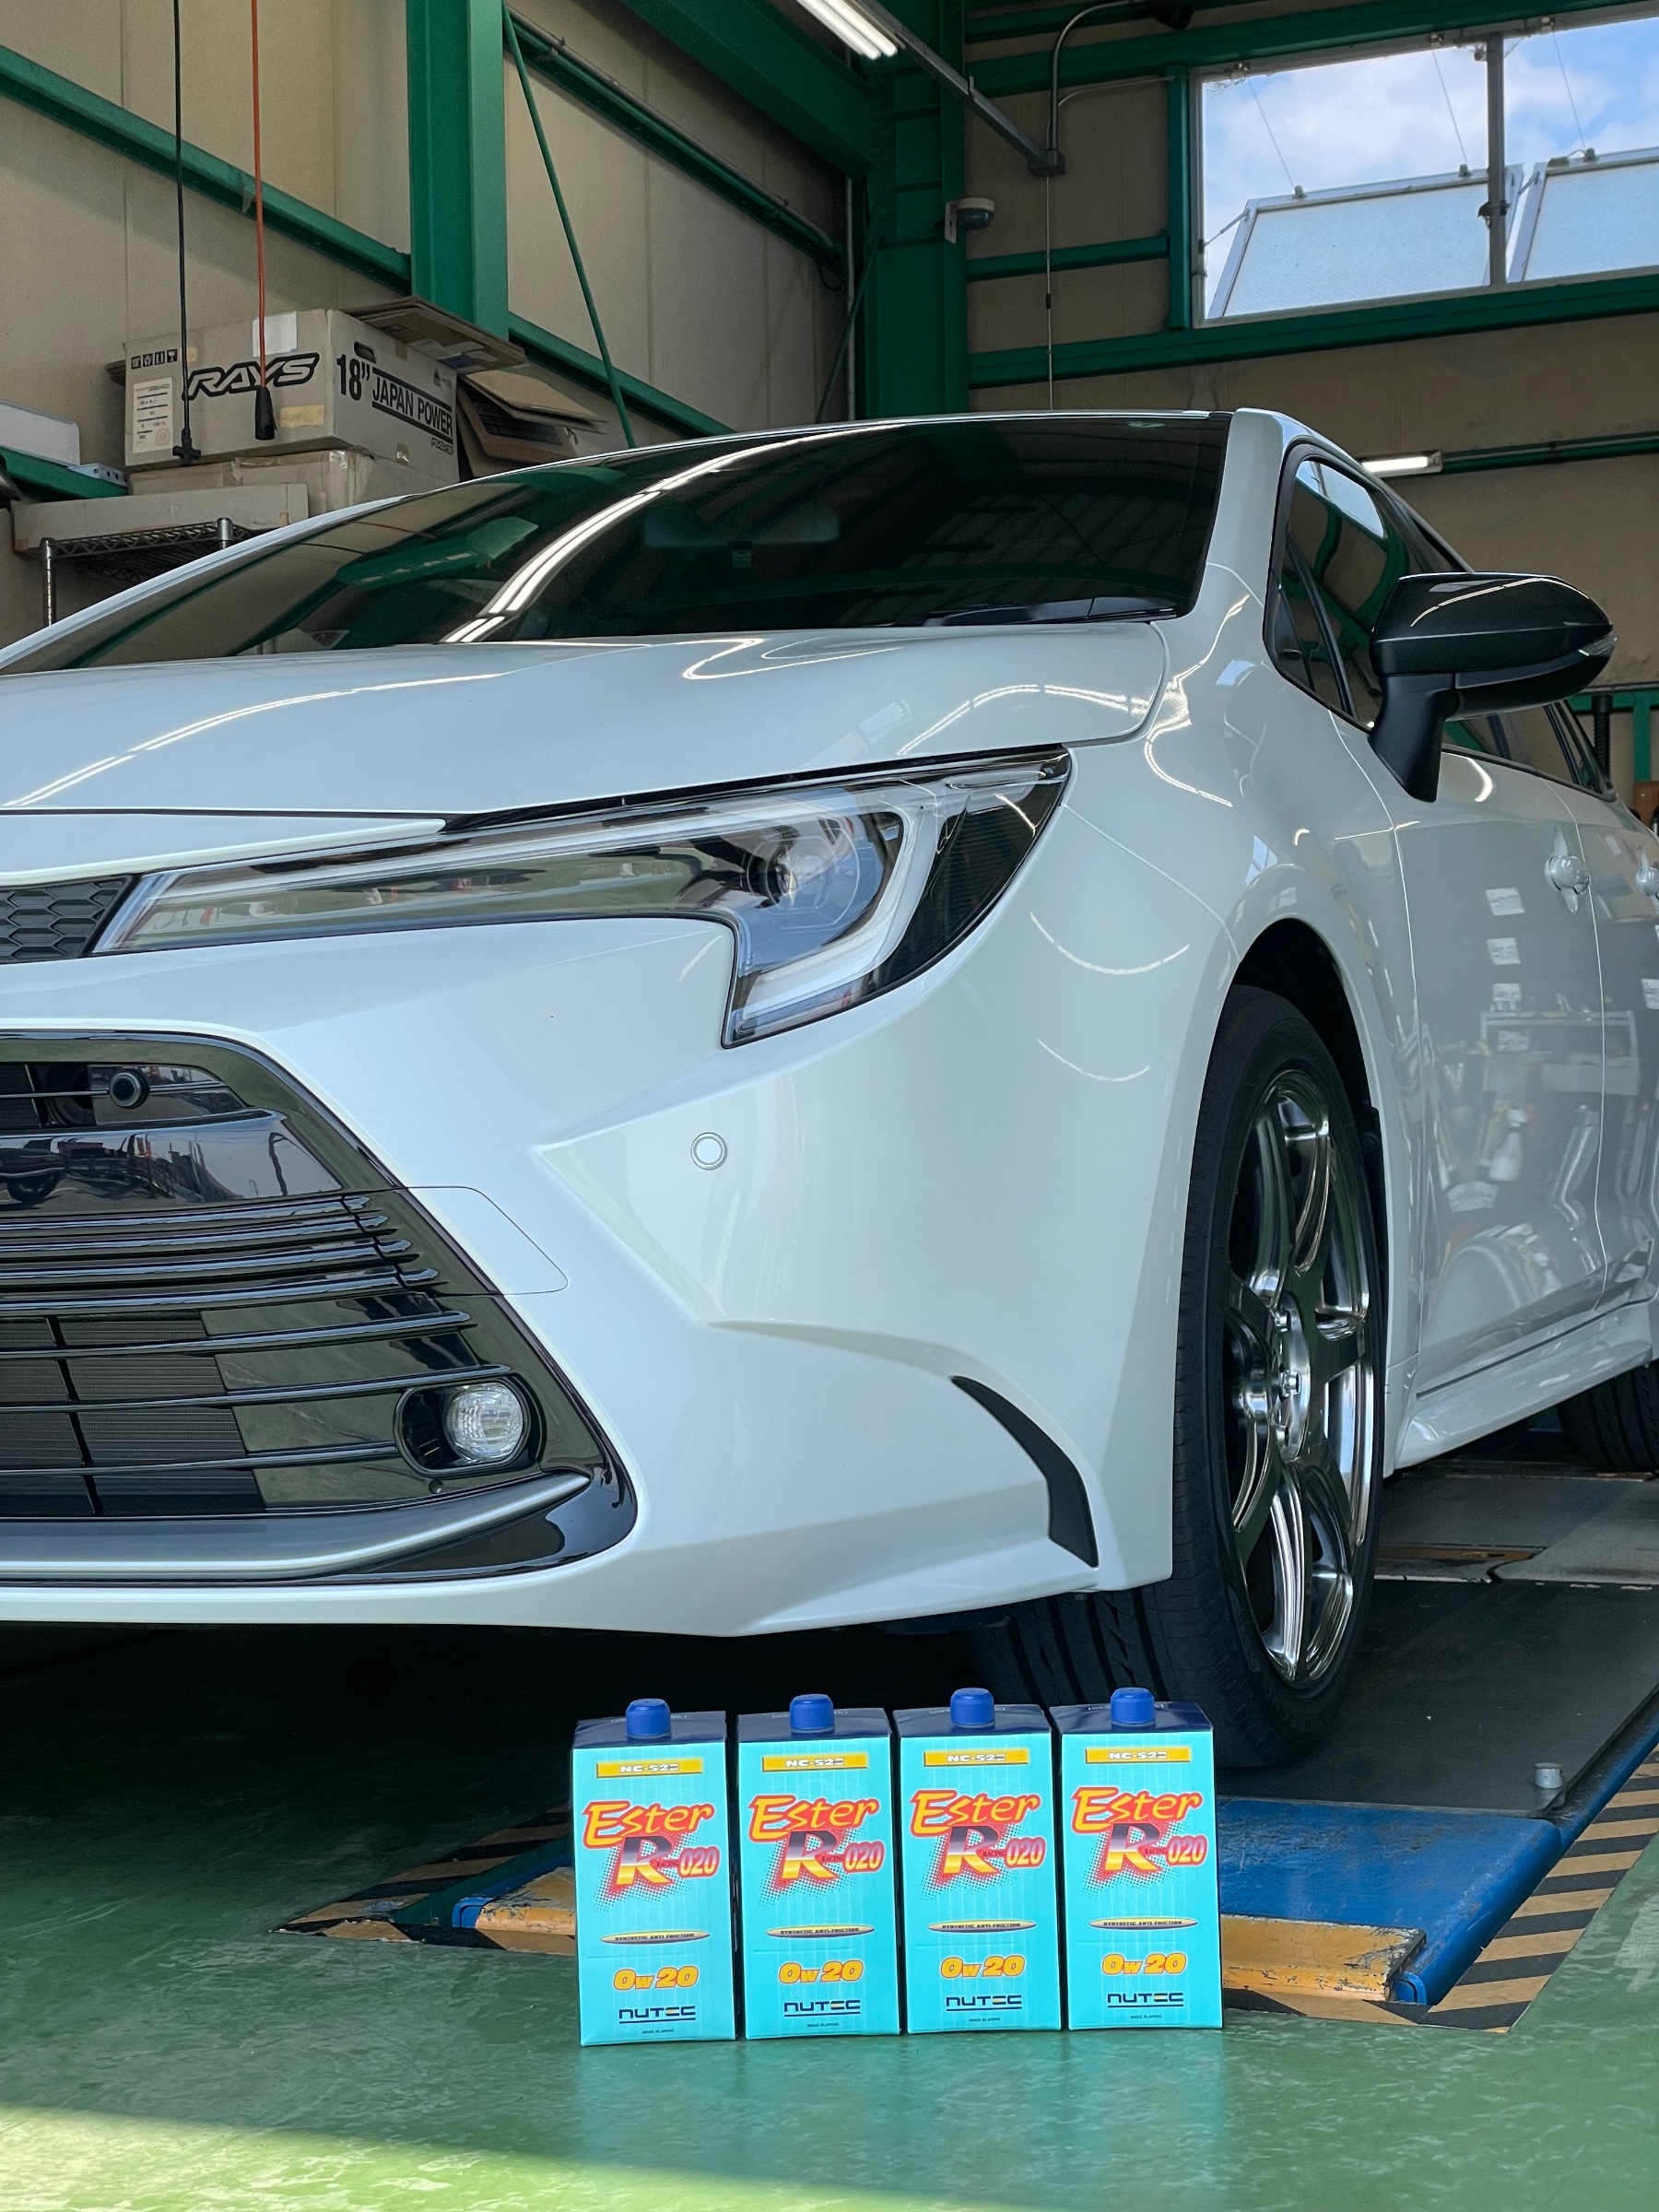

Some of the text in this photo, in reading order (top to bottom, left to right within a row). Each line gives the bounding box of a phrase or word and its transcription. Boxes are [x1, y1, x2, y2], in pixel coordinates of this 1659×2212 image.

[182, 352, 320, 401] RAYS
[372, 376, 414, 418] JAPAN
[418, 396, 453, 438] POWER
[582, 1800, 715, 1849] Ester
[747, 1794, 880, 1842] Ester
[910, 1789, 1041, 1837] Ester
[1071, 1786, 1204, 1834] Ester
[617, 1835, 674, 1885] R
[782, 1830, 840, 1879] R
[943, 1825, 1002, 1874] R
[1104, 1823, 1163, 1871] R
[618, 2006, 696, 2018] NUTEC
[784, 1999, 861, 2012] NUTEC
[946, 1994, 1022, 2006] NUTEC
[1107, 1993, 1183, 2004] NUTEC
